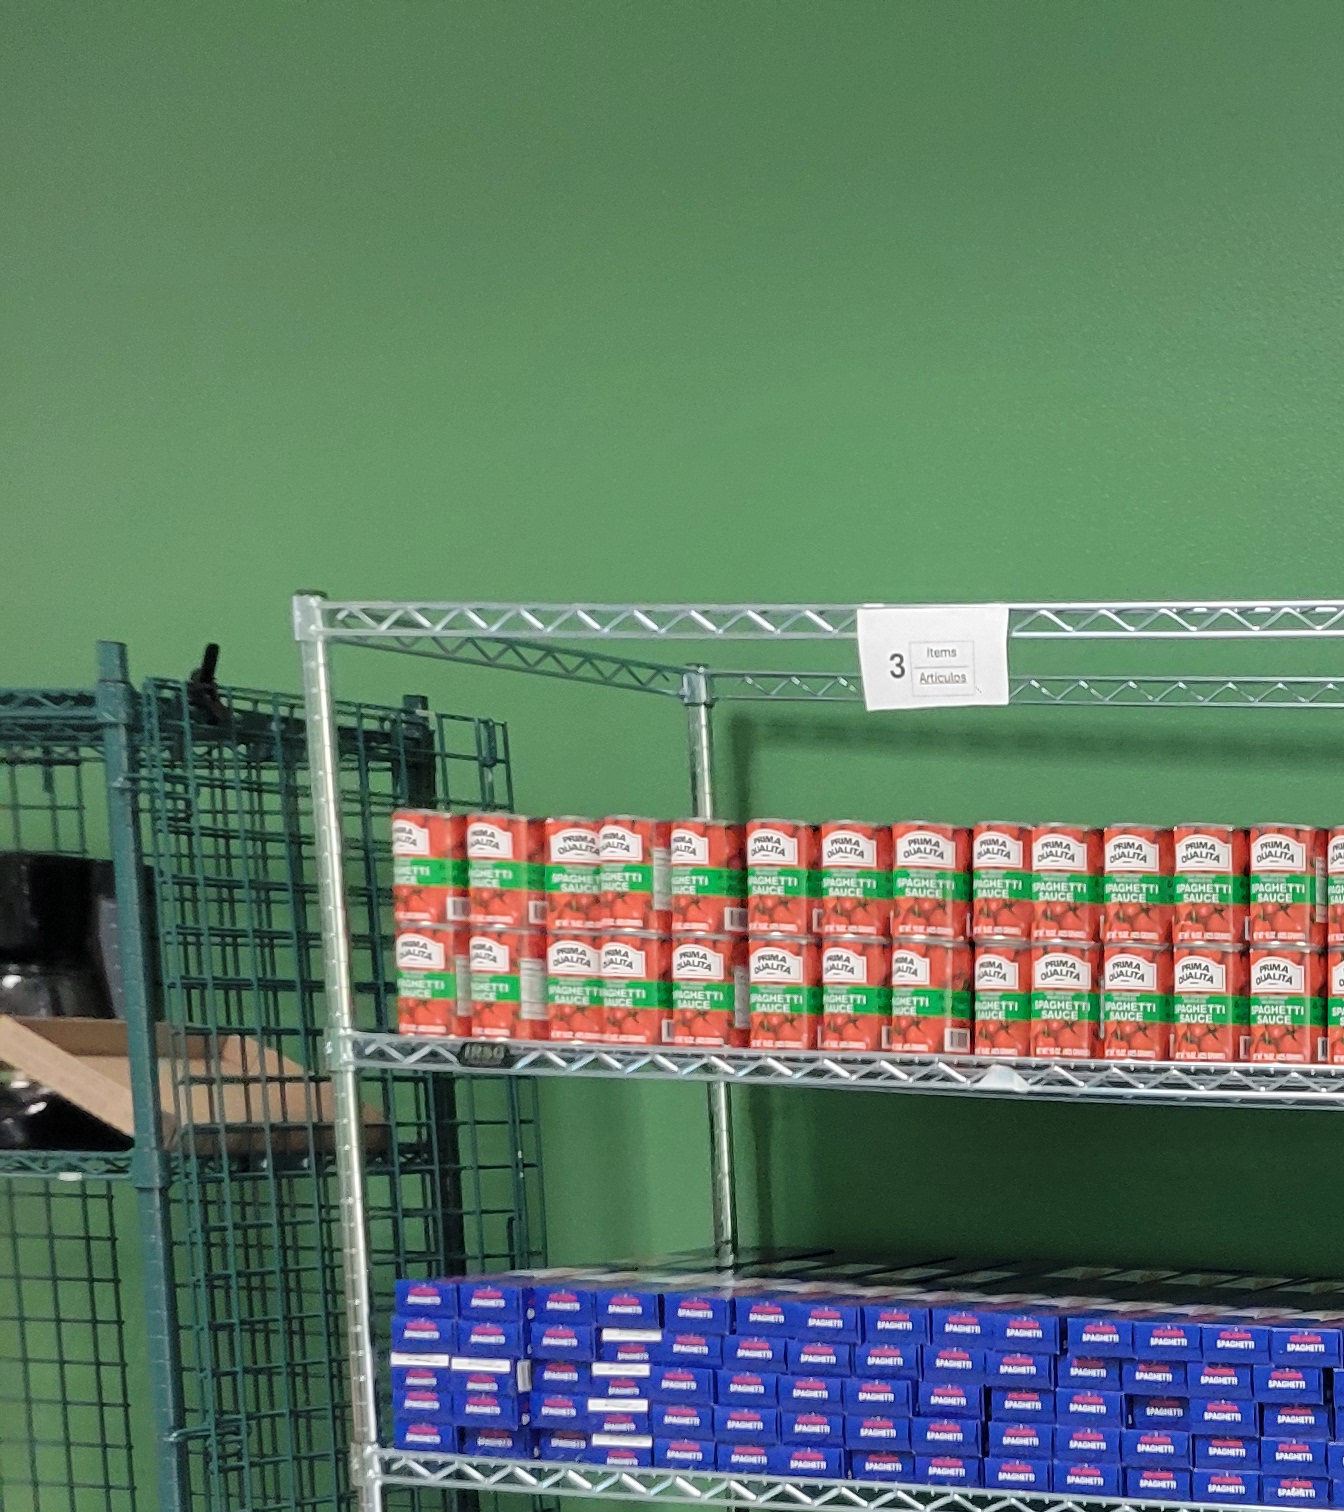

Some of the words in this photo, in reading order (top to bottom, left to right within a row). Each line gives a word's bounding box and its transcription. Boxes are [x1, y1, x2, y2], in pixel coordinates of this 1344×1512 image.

[926, 647, 957, 658] Items
[889, 653, 906, 679] 3
[919, 672, 967, 684] Artículos
[830, 836, 860, 848] PRIMA
[1185, 841, 1216, 852] PRIMA
[823, 878, 877, 889] SPAGHETTI
[1176, 883, 1232, 894] SPAGHETTI
[828, 886, 863, 897] SAUCE
[1183, 893, 1220, 904] SAUCE
[749, 1312, 785, 1324] SPAGHETTI
[877, 1320, 913, 1332] SPAGHETTI
